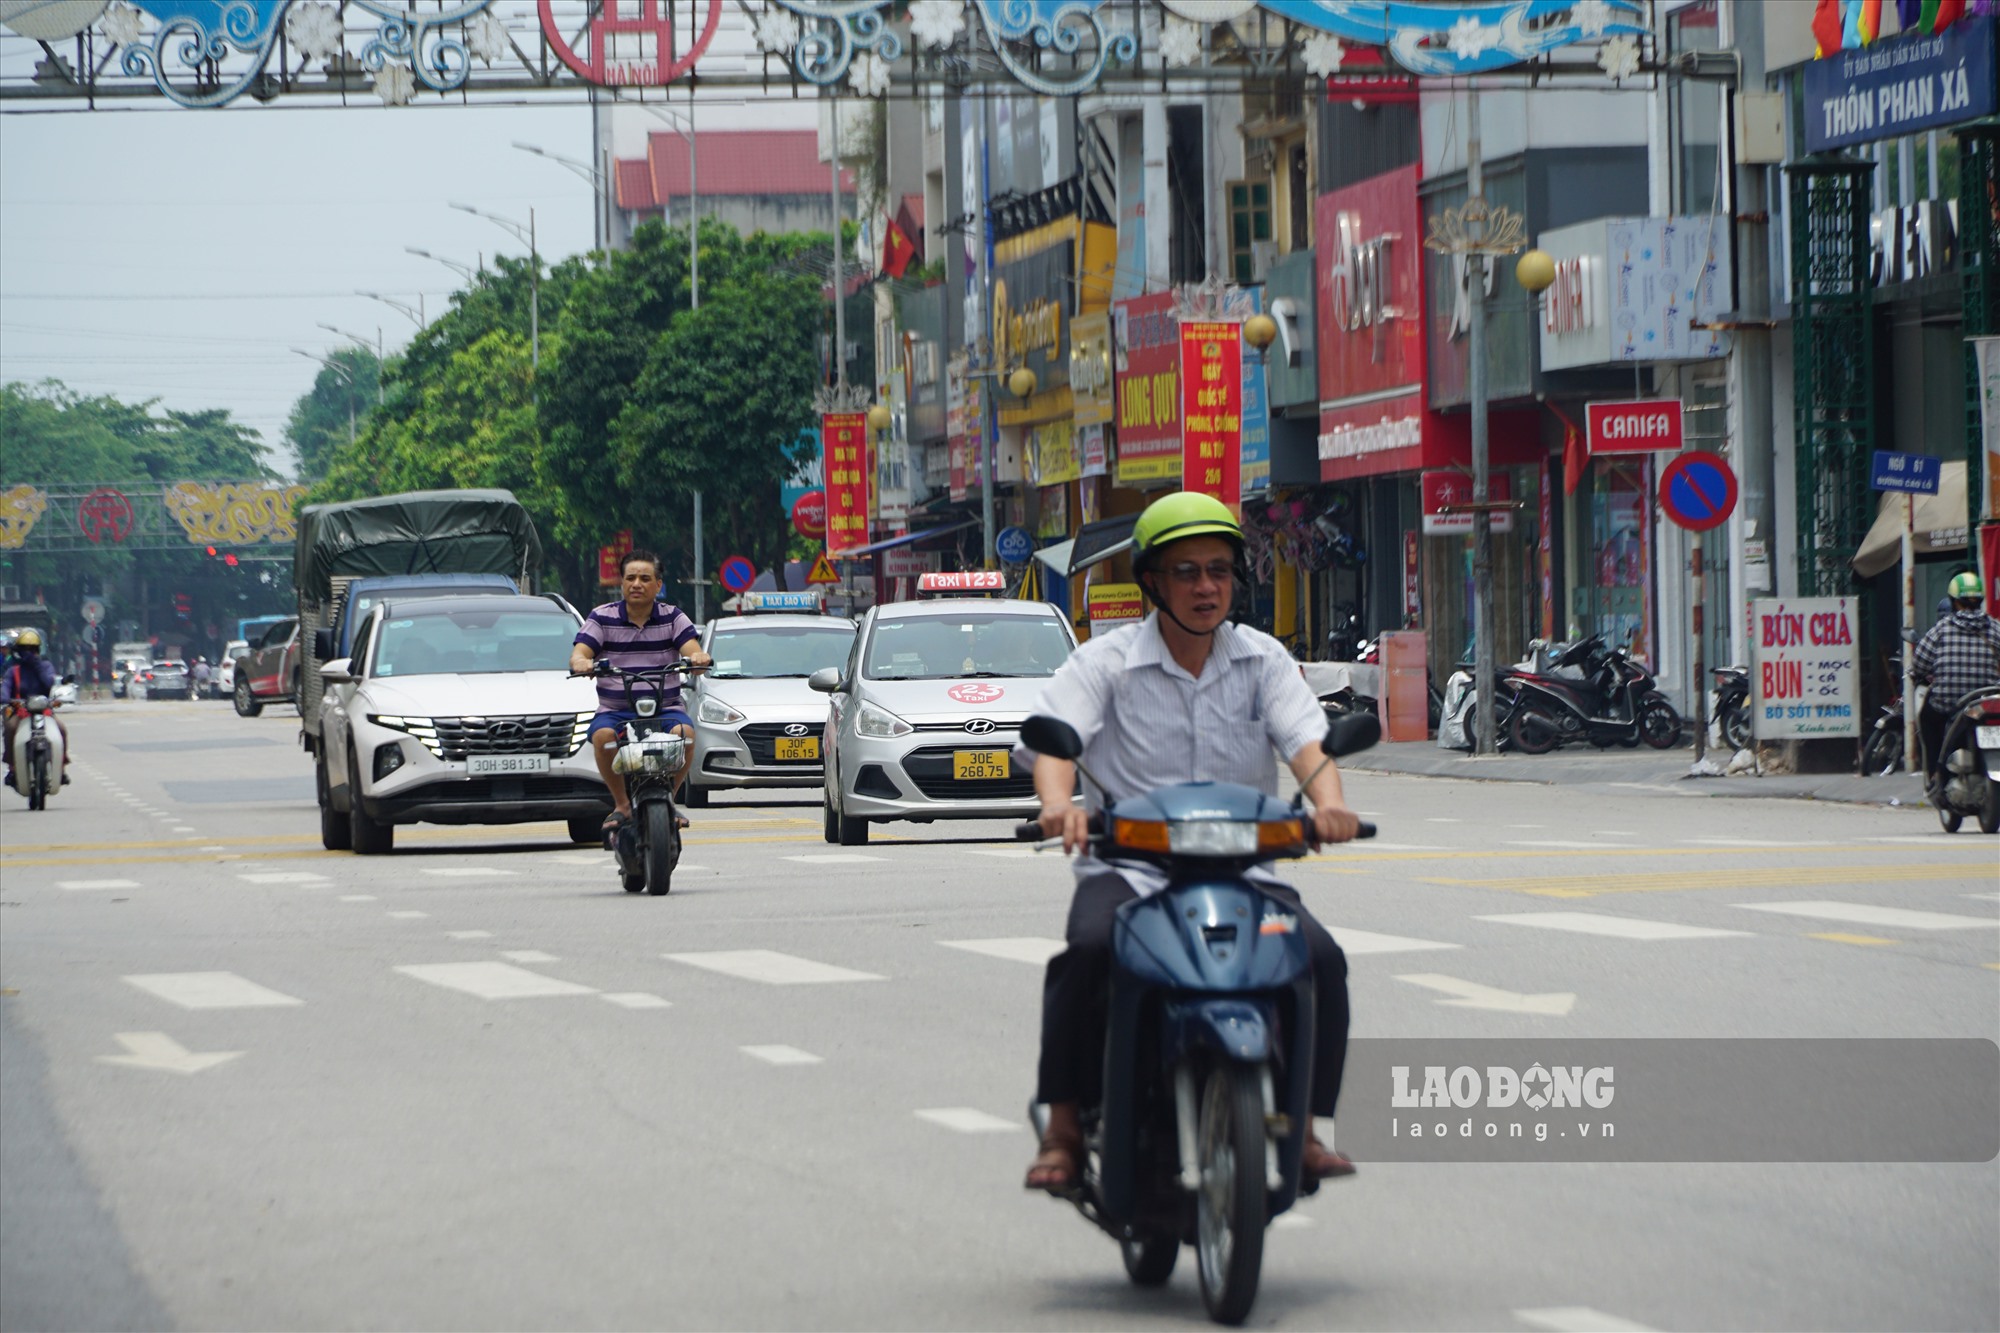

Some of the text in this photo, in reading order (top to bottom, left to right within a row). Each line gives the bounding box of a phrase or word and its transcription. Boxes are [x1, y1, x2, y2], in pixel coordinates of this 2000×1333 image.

[1823, 56, 1970, 139] THÔN PHAN XÁ
[1120, 374, 1150, 429] LONG
[1153, 362, 1177, 430] QUÝ
[1602, 414, 1669, 438] CANIFA
[927, 572, 998, 587] Taxi 123
[766, 597, 782, 606] TAXI
[784, 596, 798, 606] SAO
[1761, 604, 1804, 647] BÚN
[1809, 599, 1852, 646] CHẢ
[1817, 660, 1850, 671] MỌC
[1762, 652, 1802, 699] BÚN
[1765, 702, 1783, 719] BÒ
[1787, 700, 1812, 718] SỐT
[788, 739, 806, 748] 30F
[782, 748, 814, 758] 106.15
[970, 753, 993, 764] 30E
[474, 758, 542, 772] 30H-981.31
[960, 765, 1003, 778] 268.75
